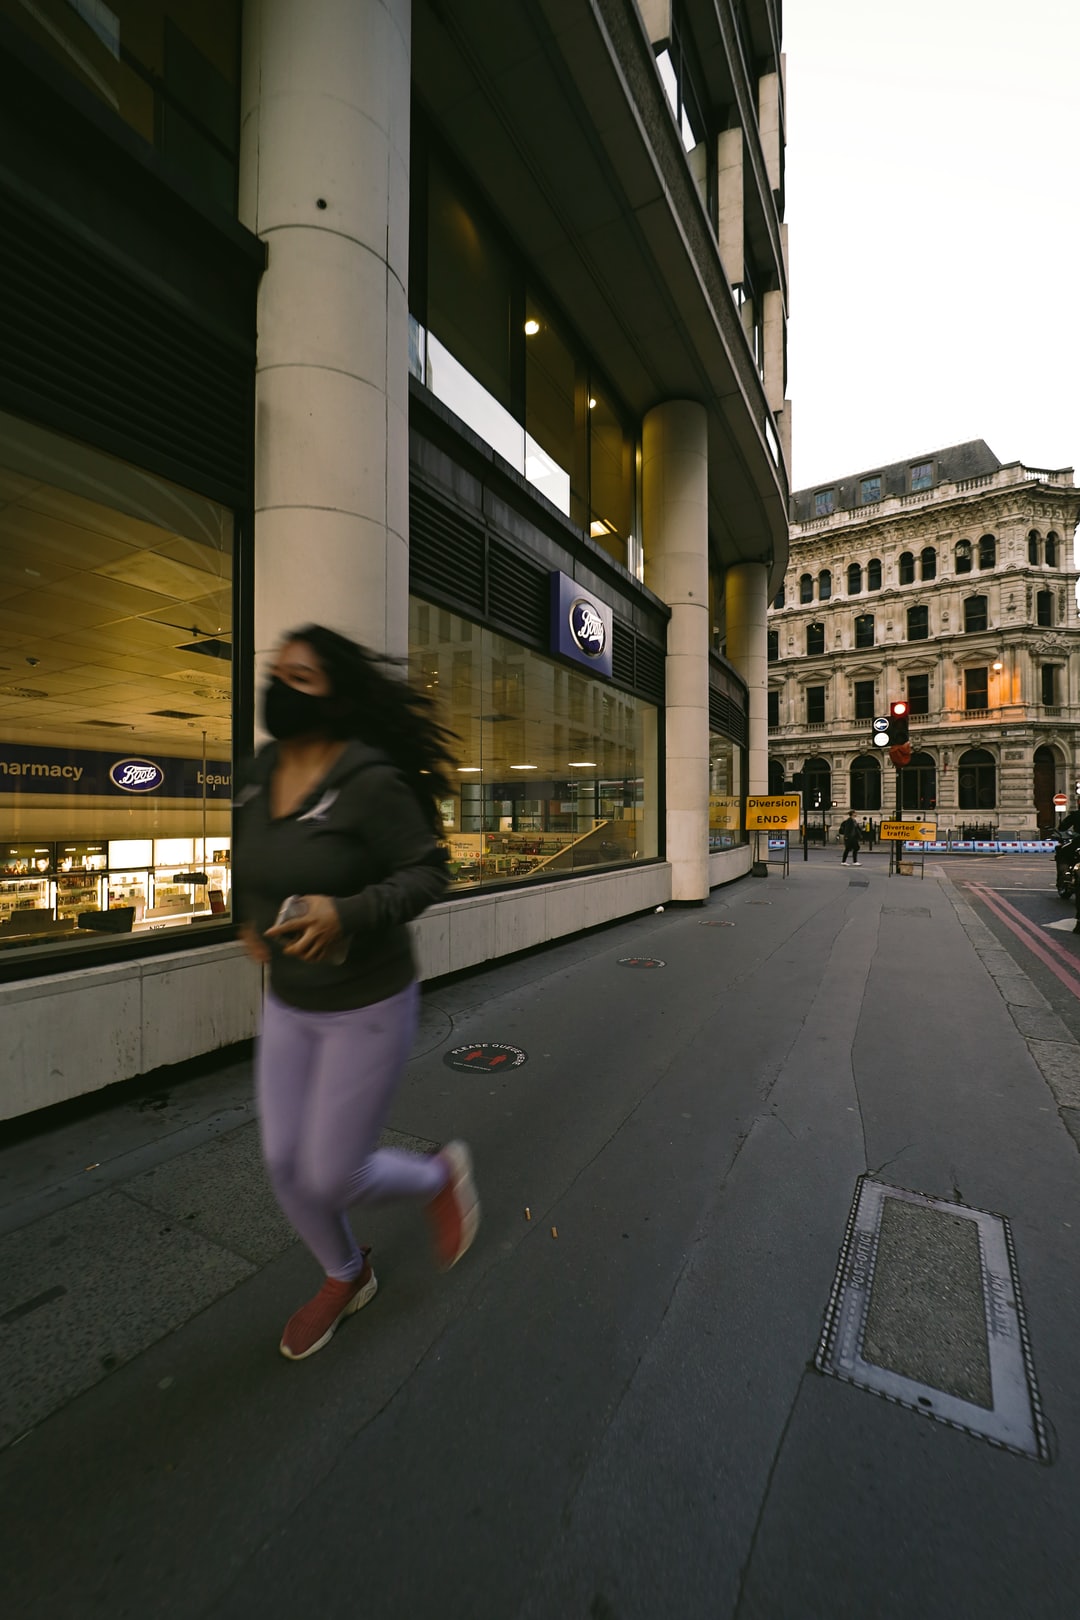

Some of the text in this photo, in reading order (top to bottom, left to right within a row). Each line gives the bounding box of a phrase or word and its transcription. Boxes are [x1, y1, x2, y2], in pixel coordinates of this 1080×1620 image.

[578, 609, 604, 642] Boots
[118, 765, 157, 785] Boots
[748, 798, 797, 808] Diversion
[756, 815, 788, 824] ENDS
[887, 830, 910, 838] traffic
[451, 1043, 526, 1066] PLEASE QUEUE HERE
